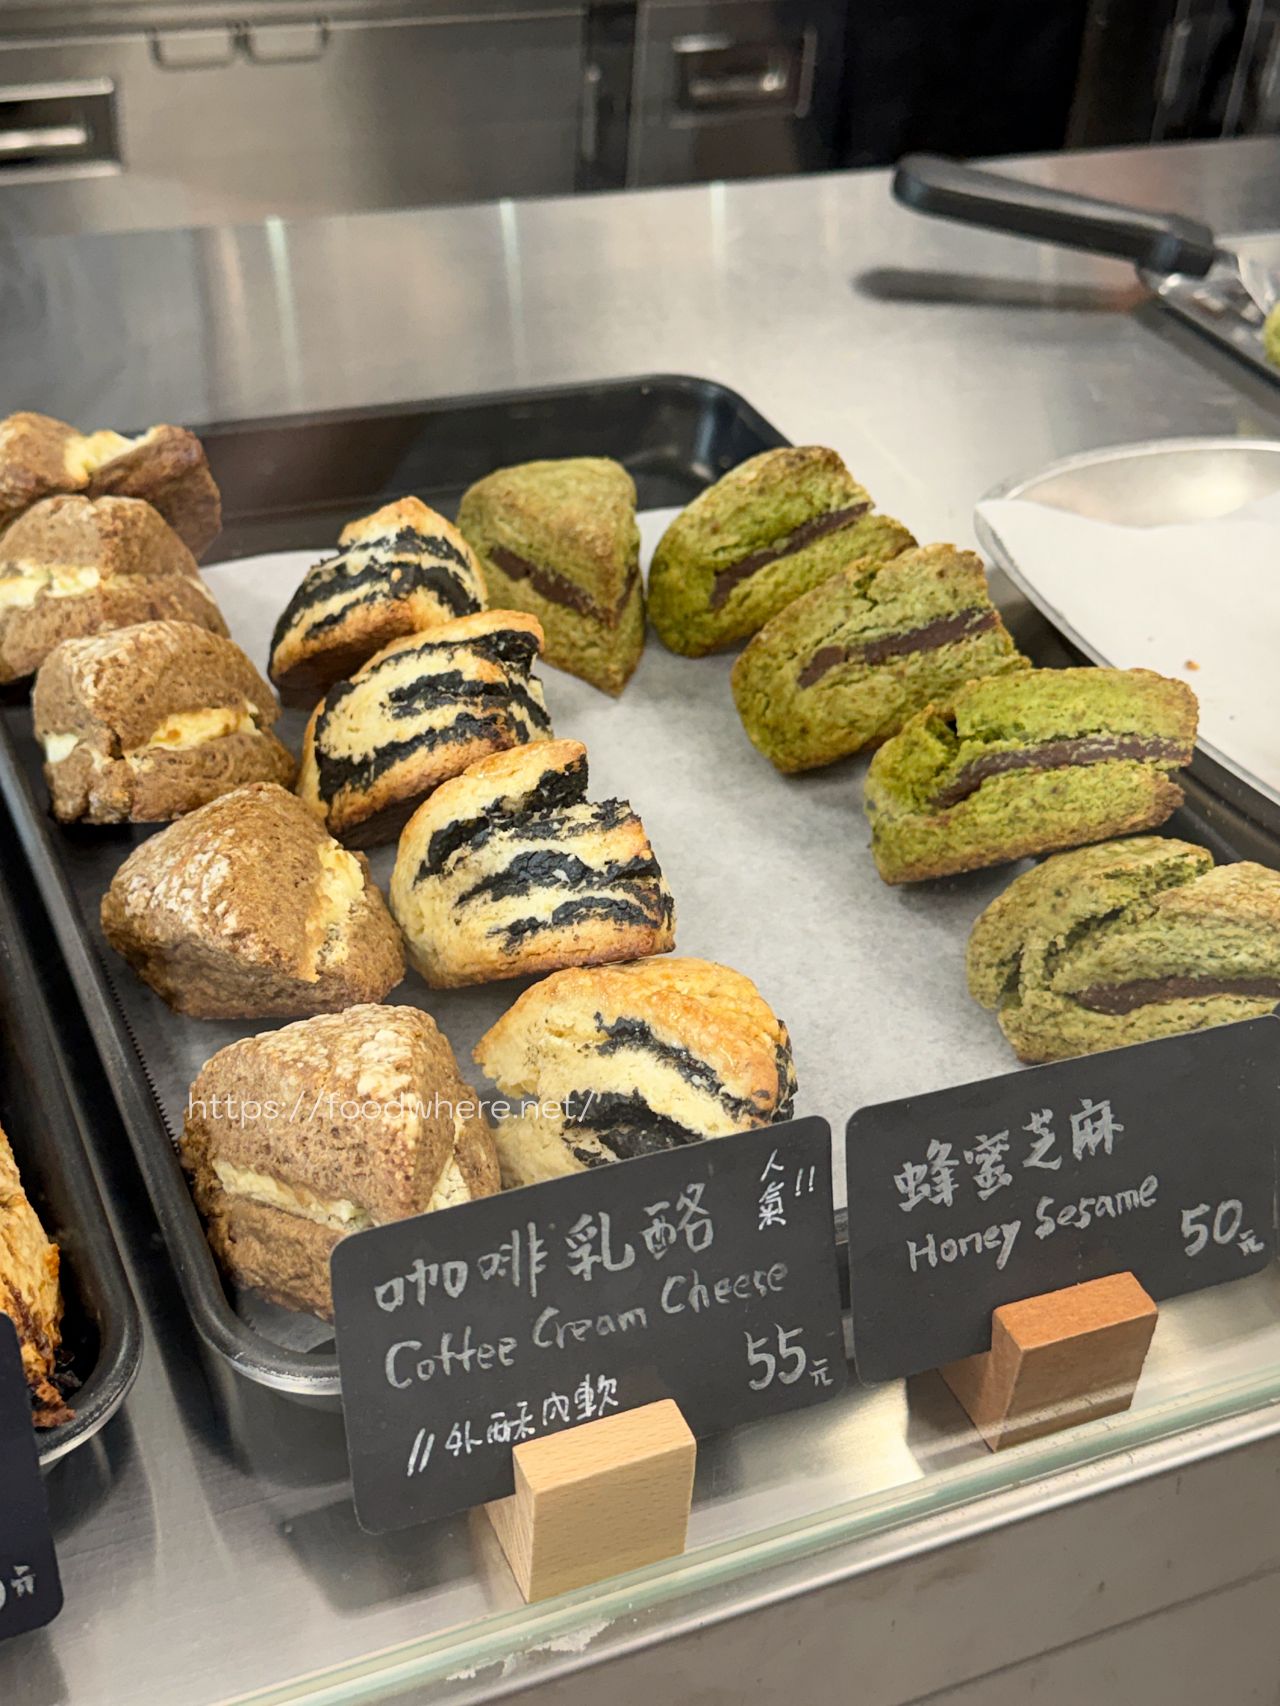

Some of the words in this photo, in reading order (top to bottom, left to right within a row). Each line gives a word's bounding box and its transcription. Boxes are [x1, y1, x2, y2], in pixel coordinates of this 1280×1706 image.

[894, 1098, 1124, 1212] 蜂蜜芝麻
[374, 1182, 714, 1312] 咖啡乳酪
[906, 1219, 1022, 1271] Honey
[1034, 1174, 1159, 1240] Sesame
[384, 1326, 518, 1389] Coffee
[532, 1306, 648, 1349] Cream
[660, 1262, 788, 1314] Cheese
[743, 1322, 834, 1391] 55元
